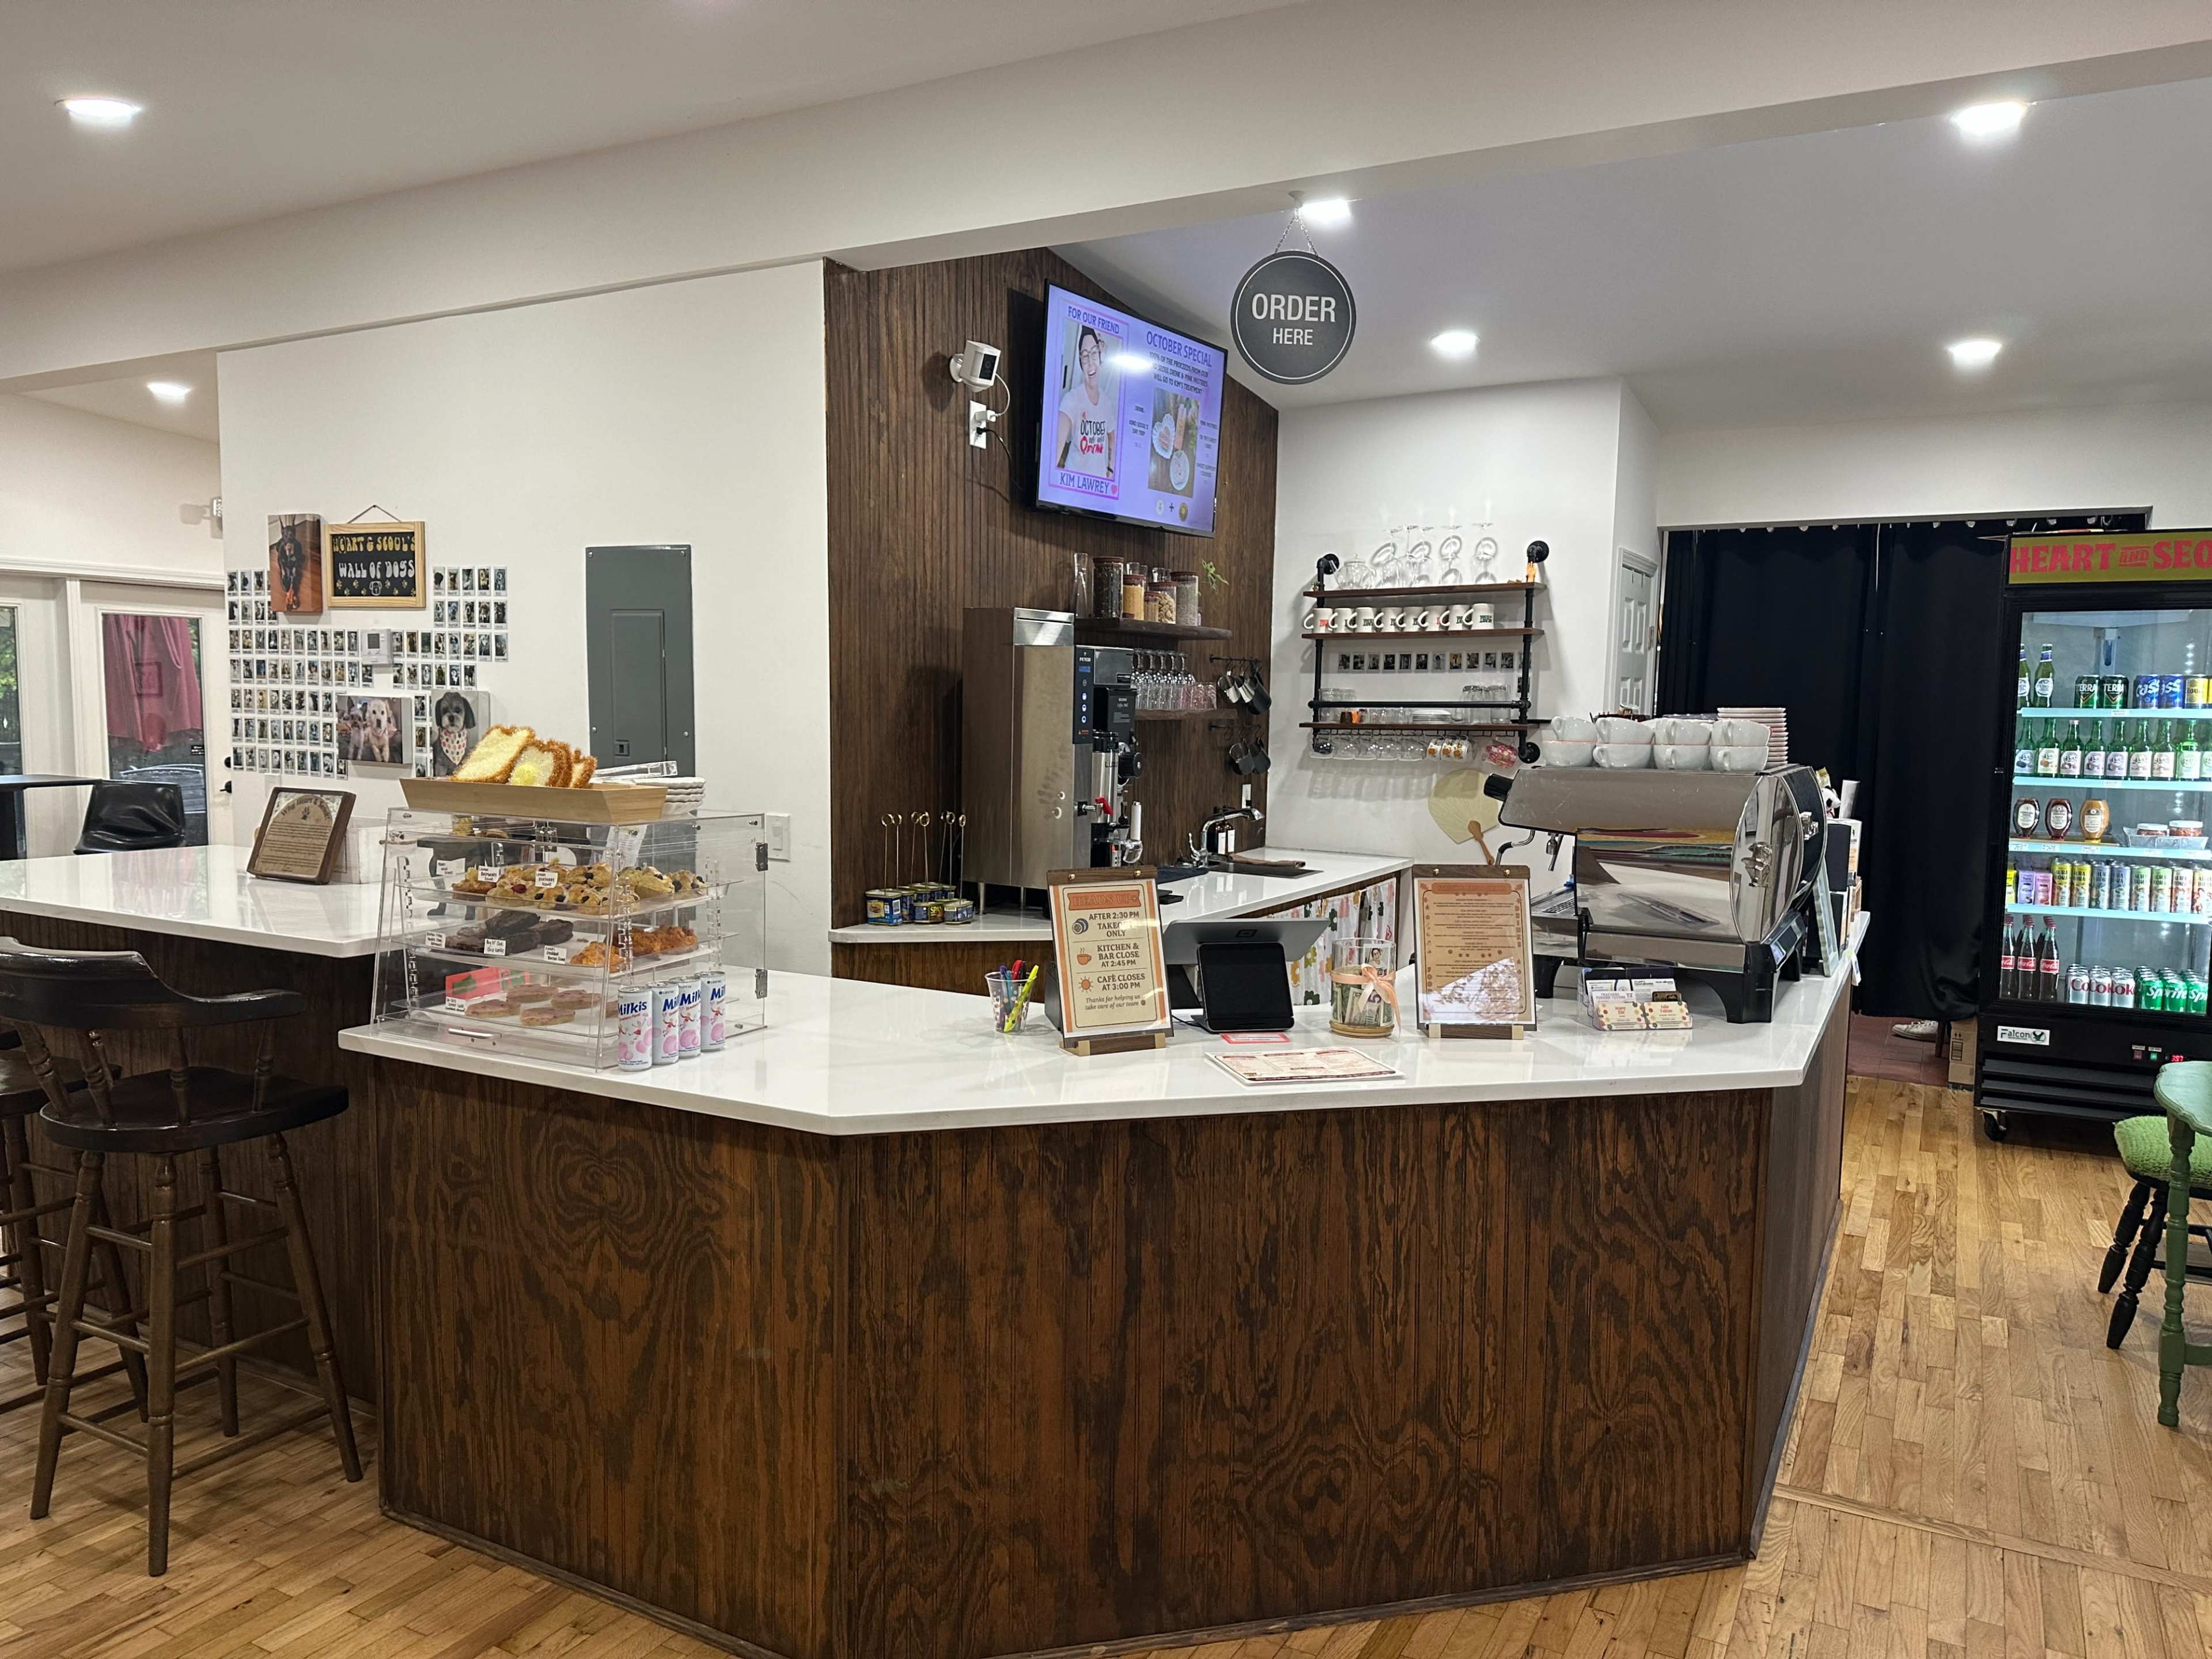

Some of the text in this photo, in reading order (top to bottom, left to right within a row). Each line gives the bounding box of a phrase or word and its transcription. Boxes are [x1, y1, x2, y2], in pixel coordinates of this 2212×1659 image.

[1252, 293, 1336, 323] ORDER
[1068, 306, 1120, 334] FOR OUR FRIEND
[1273, 328, 1313, 345] HERE
[1147, 331, 1211, 367] OCTOBER SPECIAL
[1060, 472, 1110, 494] KIM LAWREY
[2009, 543, 2118, 573] HEART
[339, 562, 367, 578] WALL
[369, 562, 381, 579] OF
[1089, 912, 1111, 921] AFTER
[1097, 943, 1131, 952] KITCHEN
[1097, 973, 1145, 983] CAFÉ CLOSES
[1105, 995, 1113, 1003] for
[2001, 1029, 2031, 1039] Falcon
